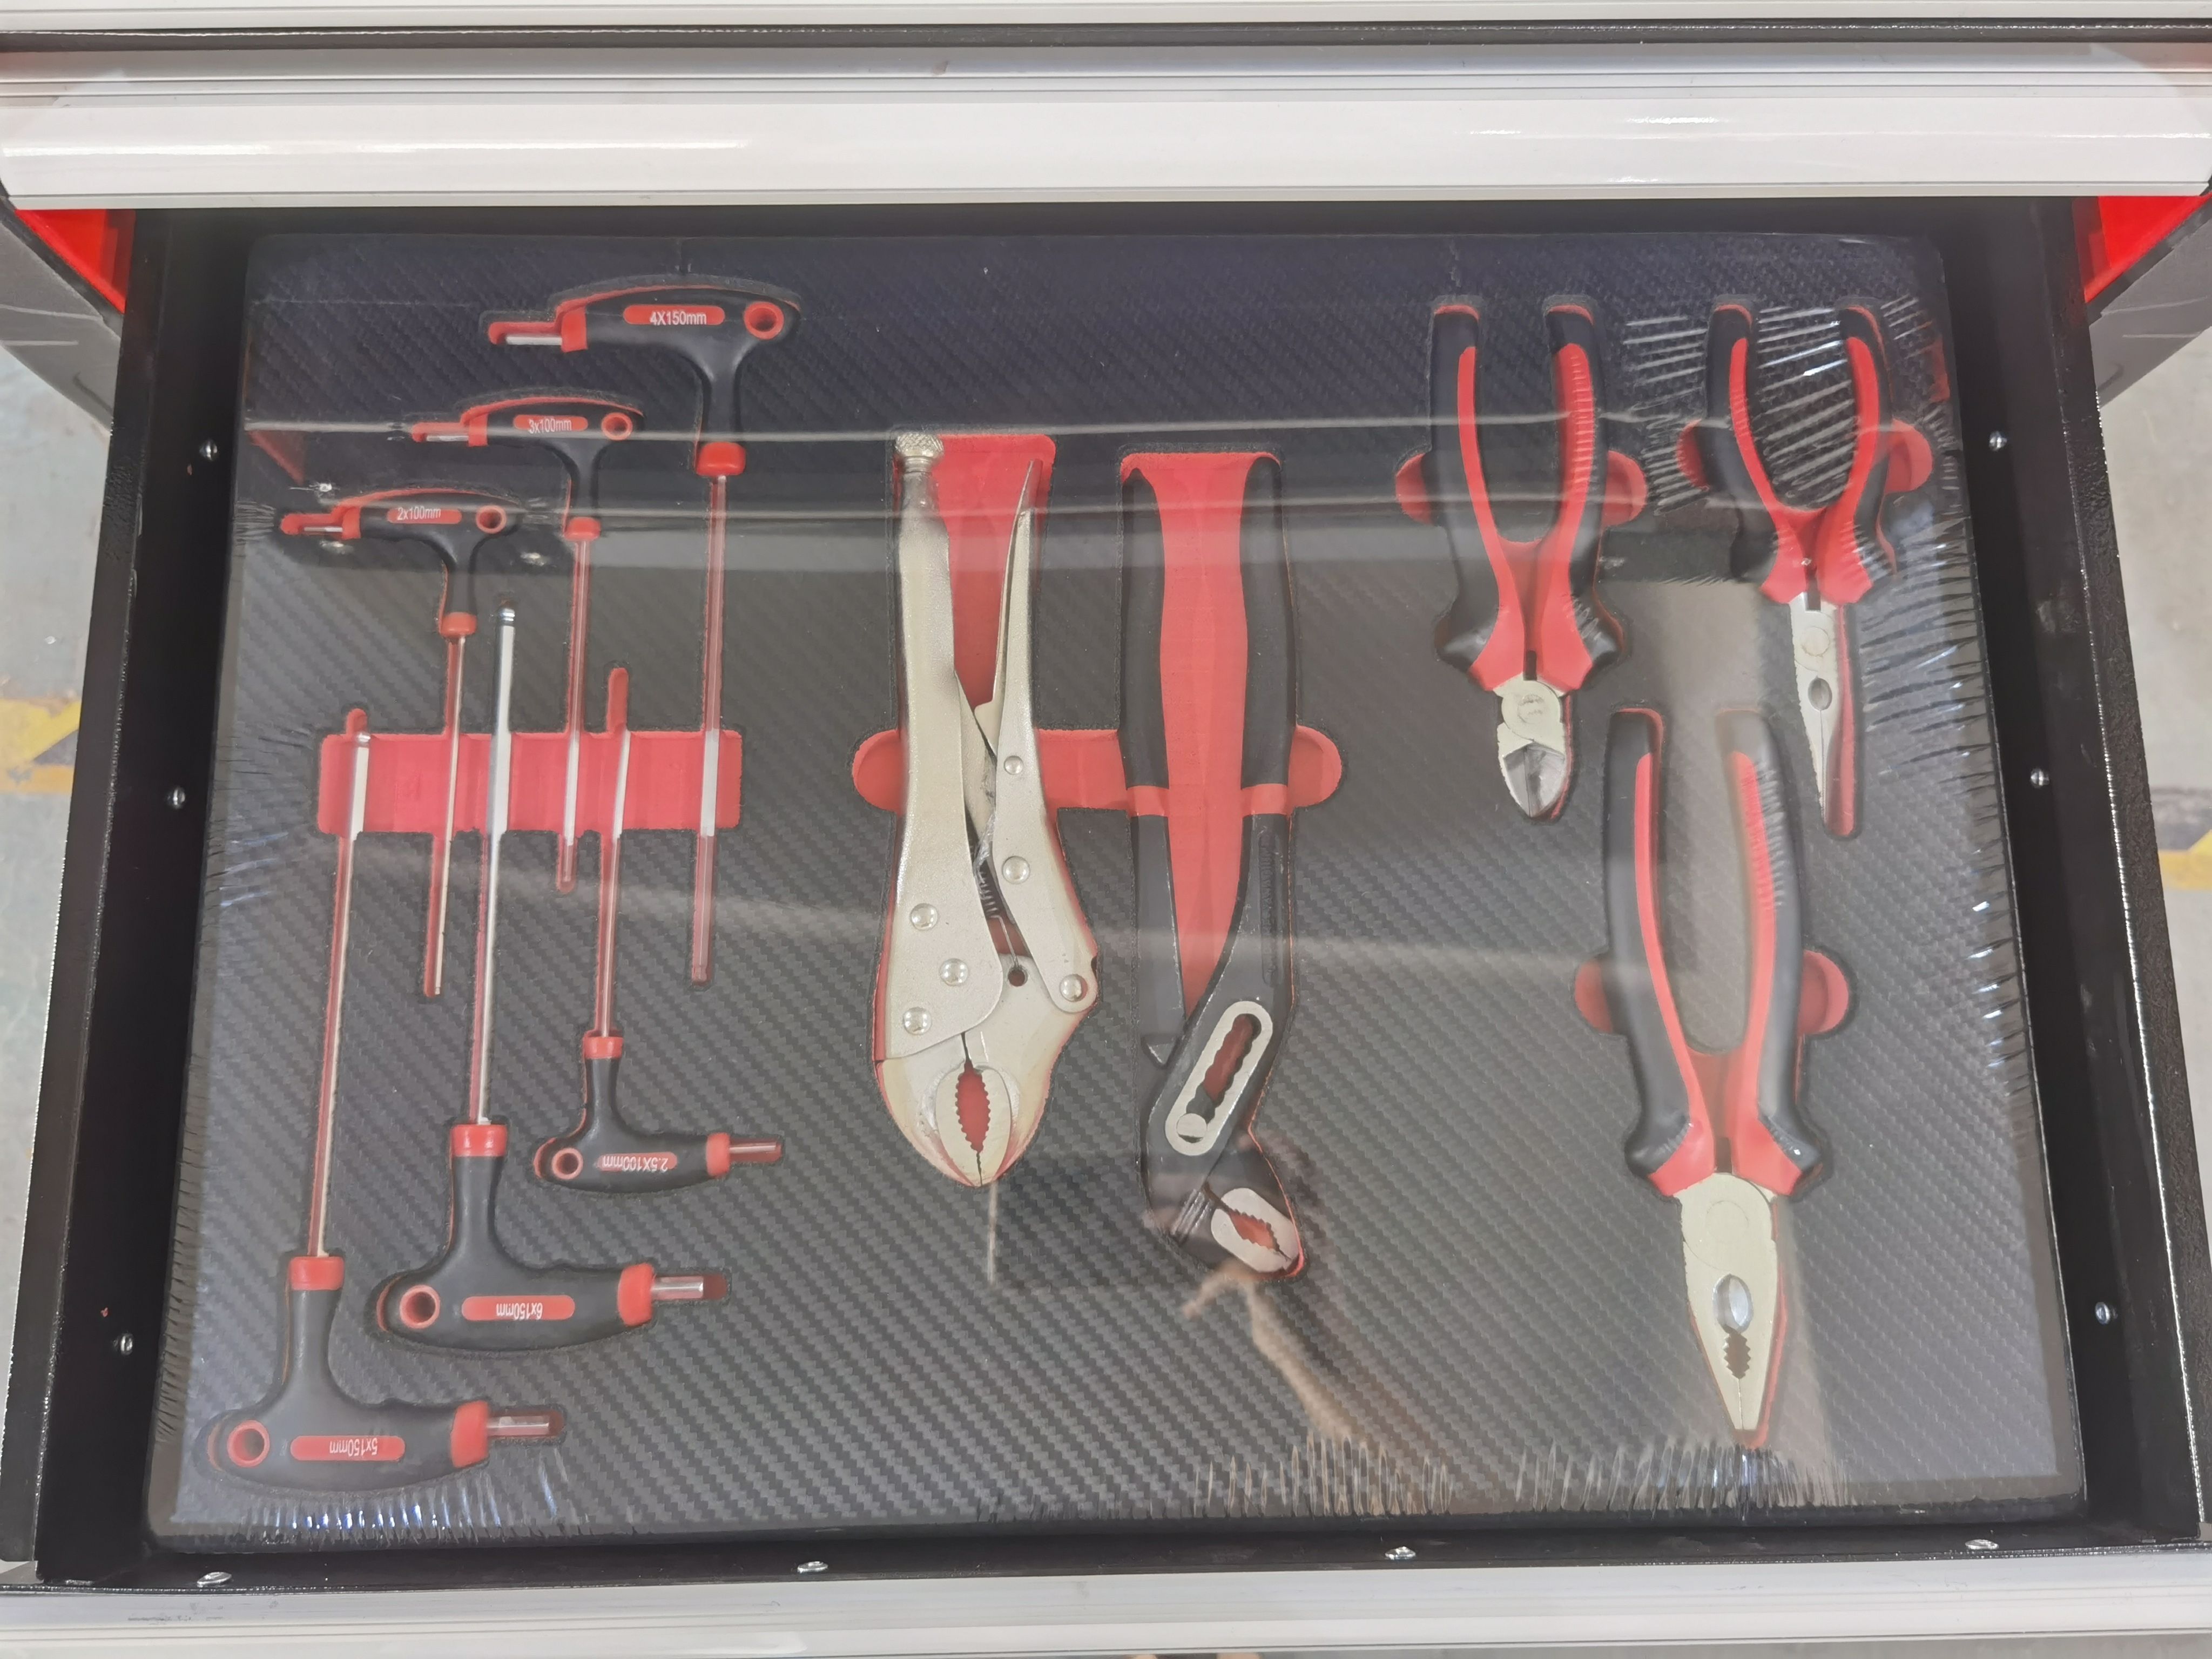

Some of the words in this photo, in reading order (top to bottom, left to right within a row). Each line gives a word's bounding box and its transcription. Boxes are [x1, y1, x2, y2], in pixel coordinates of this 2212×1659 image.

[649, 311, 706, 325] 4X150mm
[529, 417, 572, 434] 3x100mm
[397, 506, 441, 521] 2x100mm
[603, 1156, 668, 1172] 2.5X100mm
[496, 1301, 543, 1320] 6x150mm
[329, 1437, 378, 1456] 5x150mm
